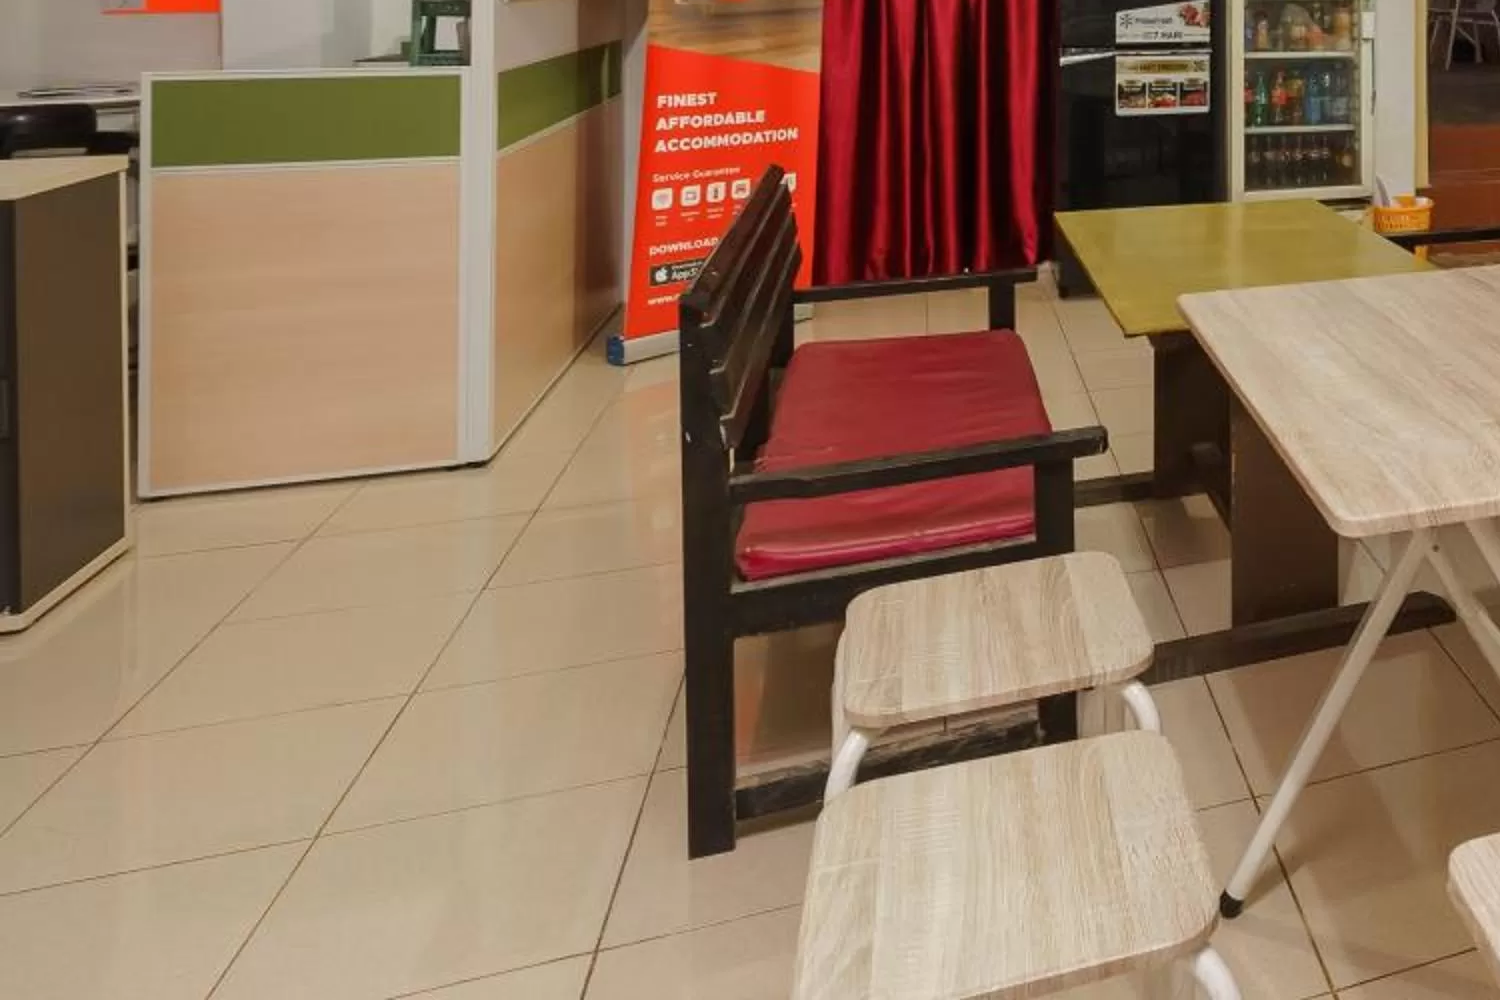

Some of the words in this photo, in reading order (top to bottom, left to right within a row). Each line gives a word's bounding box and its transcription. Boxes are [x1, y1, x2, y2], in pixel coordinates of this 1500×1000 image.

[656, 91, 718, 109] FINEST
[655, 110, 766, 132] AFFORDABLE
[654, 127, 800, 154] ACCOMMODATION
[652, 170, 691, 183] Service
[649, 236, 719, 256] DOWNLOAD
